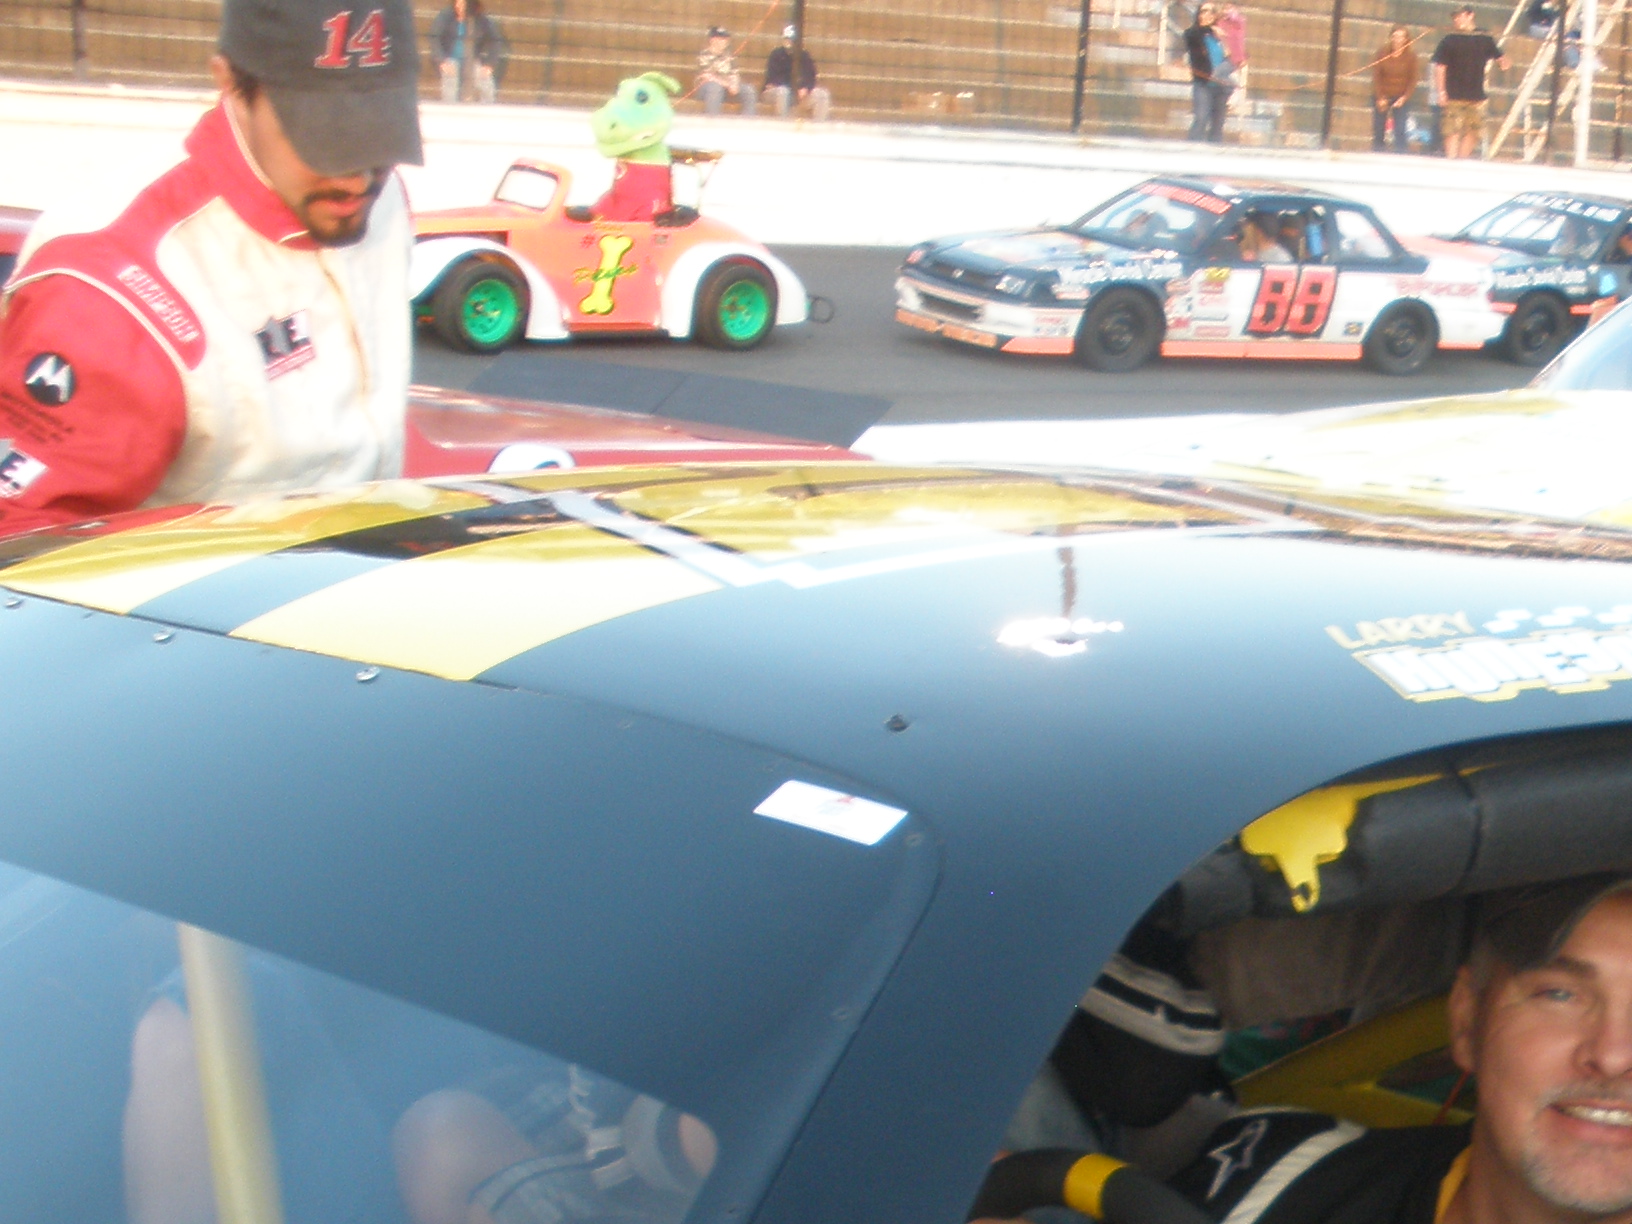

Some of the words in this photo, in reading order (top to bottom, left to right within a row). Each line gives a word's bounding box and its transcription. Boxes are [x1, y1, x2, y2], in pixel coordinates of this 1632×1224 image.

[314, 9, 391, 68] 14
[1243, 264, 1337, 337] 88
[1324, 611, 1475, 649] LARRY
